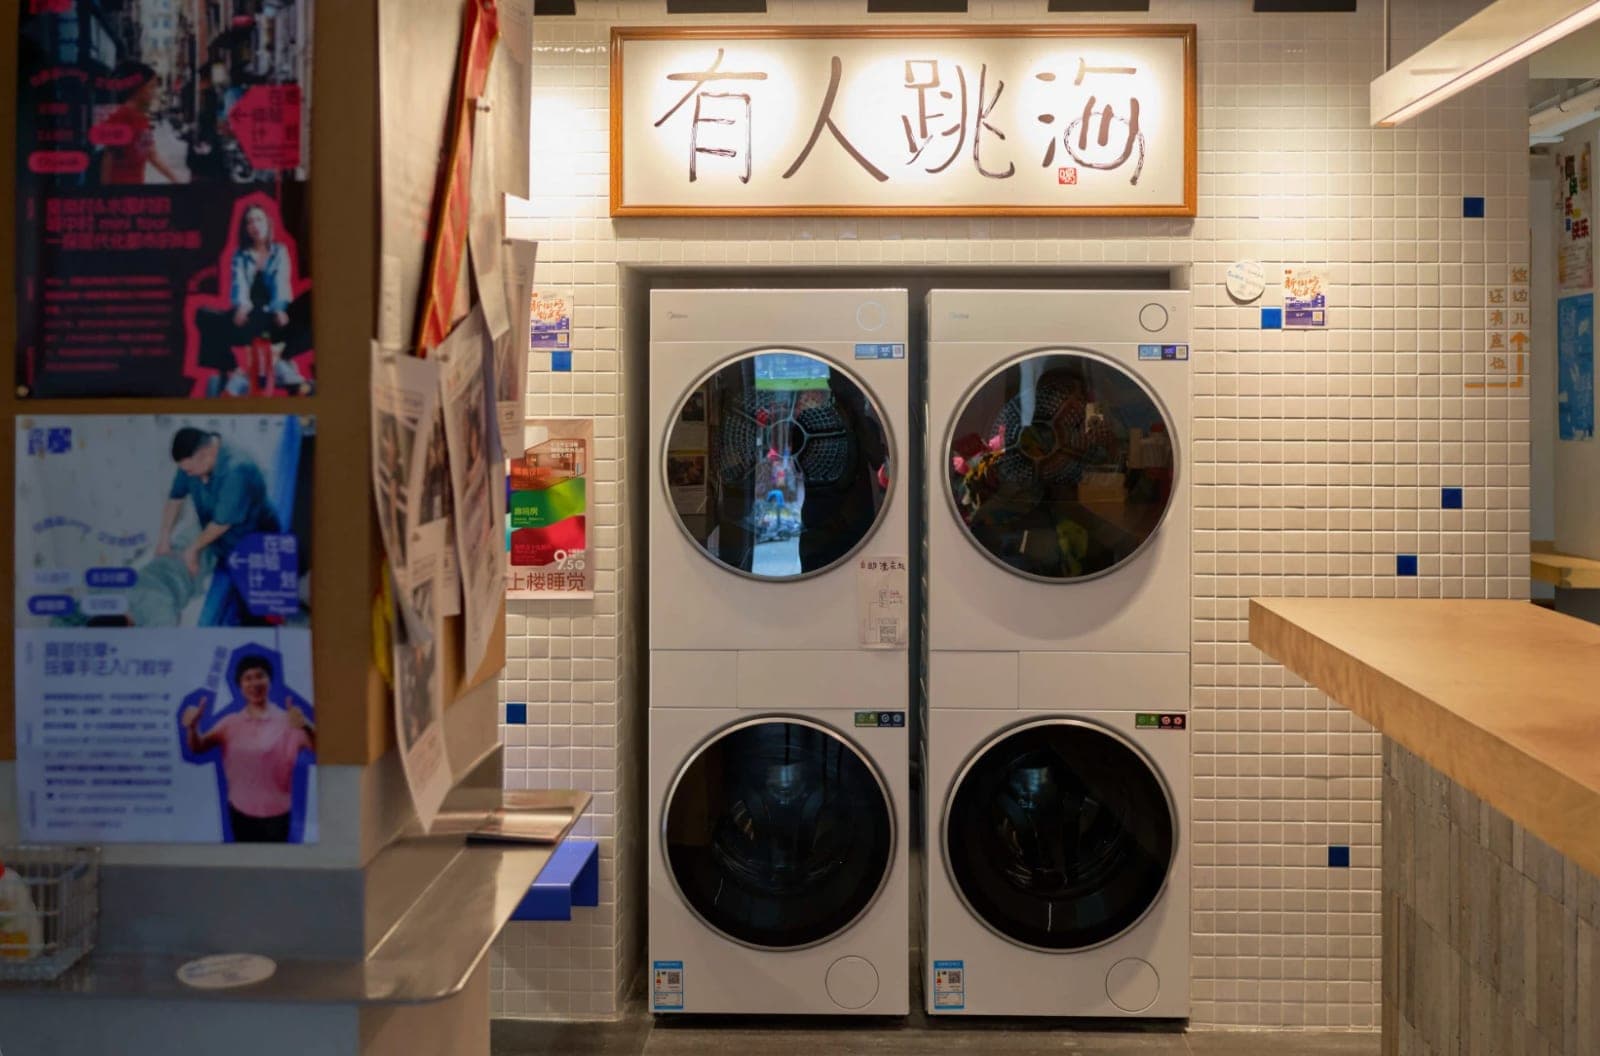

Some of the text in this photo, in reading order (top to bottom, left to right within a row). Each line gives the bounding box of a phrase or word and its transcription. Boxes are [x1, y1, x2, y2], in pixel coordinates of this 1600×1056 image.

[654, 48, 1146, 185] 有人跳海
[507, 572, 585, 591] 上楼睡觉
